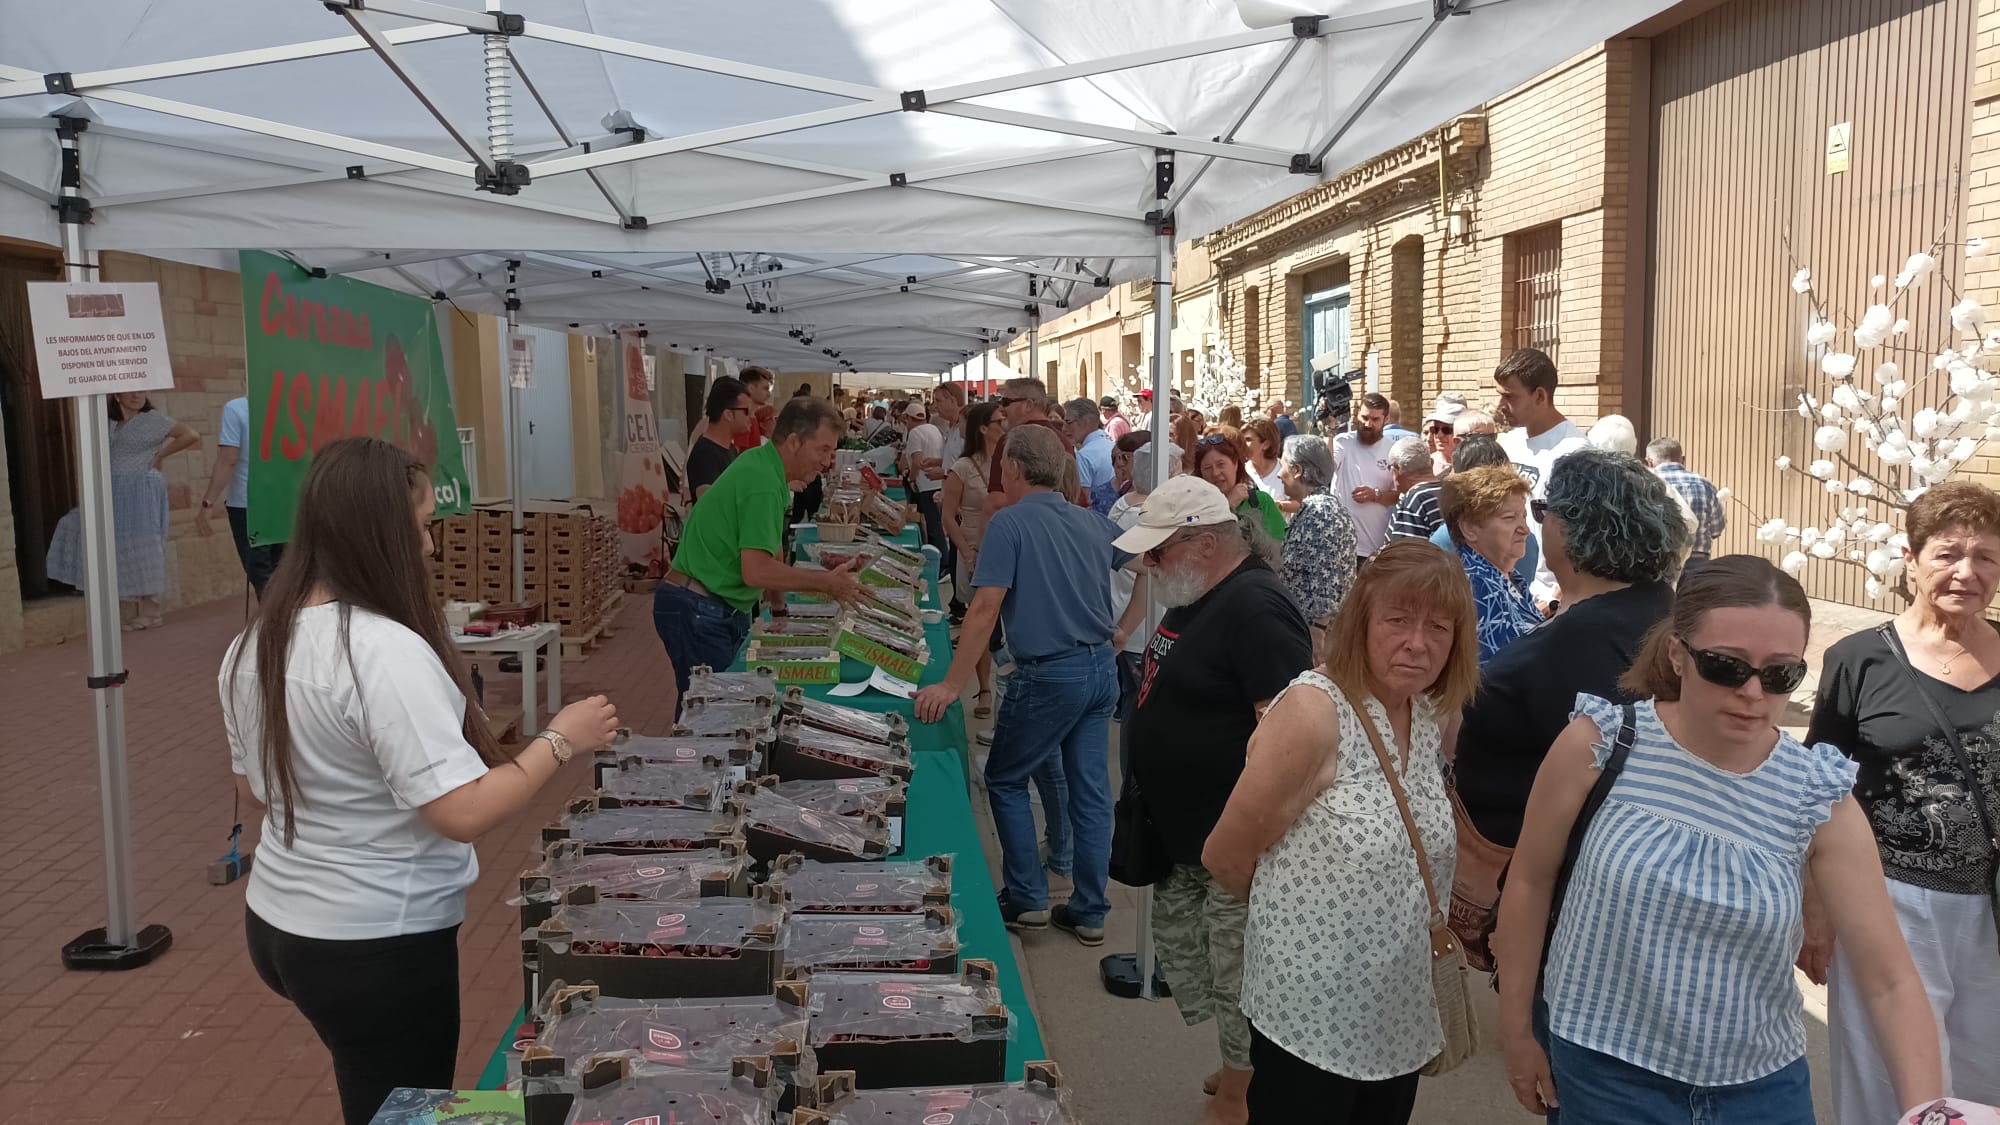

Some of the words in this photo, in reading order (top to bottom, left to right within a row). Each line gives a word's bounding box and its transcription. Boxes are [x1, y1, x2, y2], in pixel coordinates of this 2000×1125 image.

[46, 336, 57, 344] LES
[59, 334, 105, 344] INFORMAMOS
[116, 333, 131, 341] QUE
[132, 332, 141, 340] EN
[142, 332, 155, 340] LOS
[58, 348, 79, 357] BAJOS
[80, 347, 93, 356] DEL
[94, 345, 147, 355] AYUNTAMIENTO
[61, 361, 95, 370] DISPONEN
[96, 360, 105, 368] DE
[106, 359, 117, 367] UN
[118, 357, 148, 366] SERVICIO
[68, 376, 78, 384] DE
[79, 374, 107, 383] GUARDA
[108, 373, 117, 381] DE
[118, 371, 147, 380] CEREZAS
[865, 647, 913, 678] ISMAEL
[778, 665, 829, 680] ISMAEL
